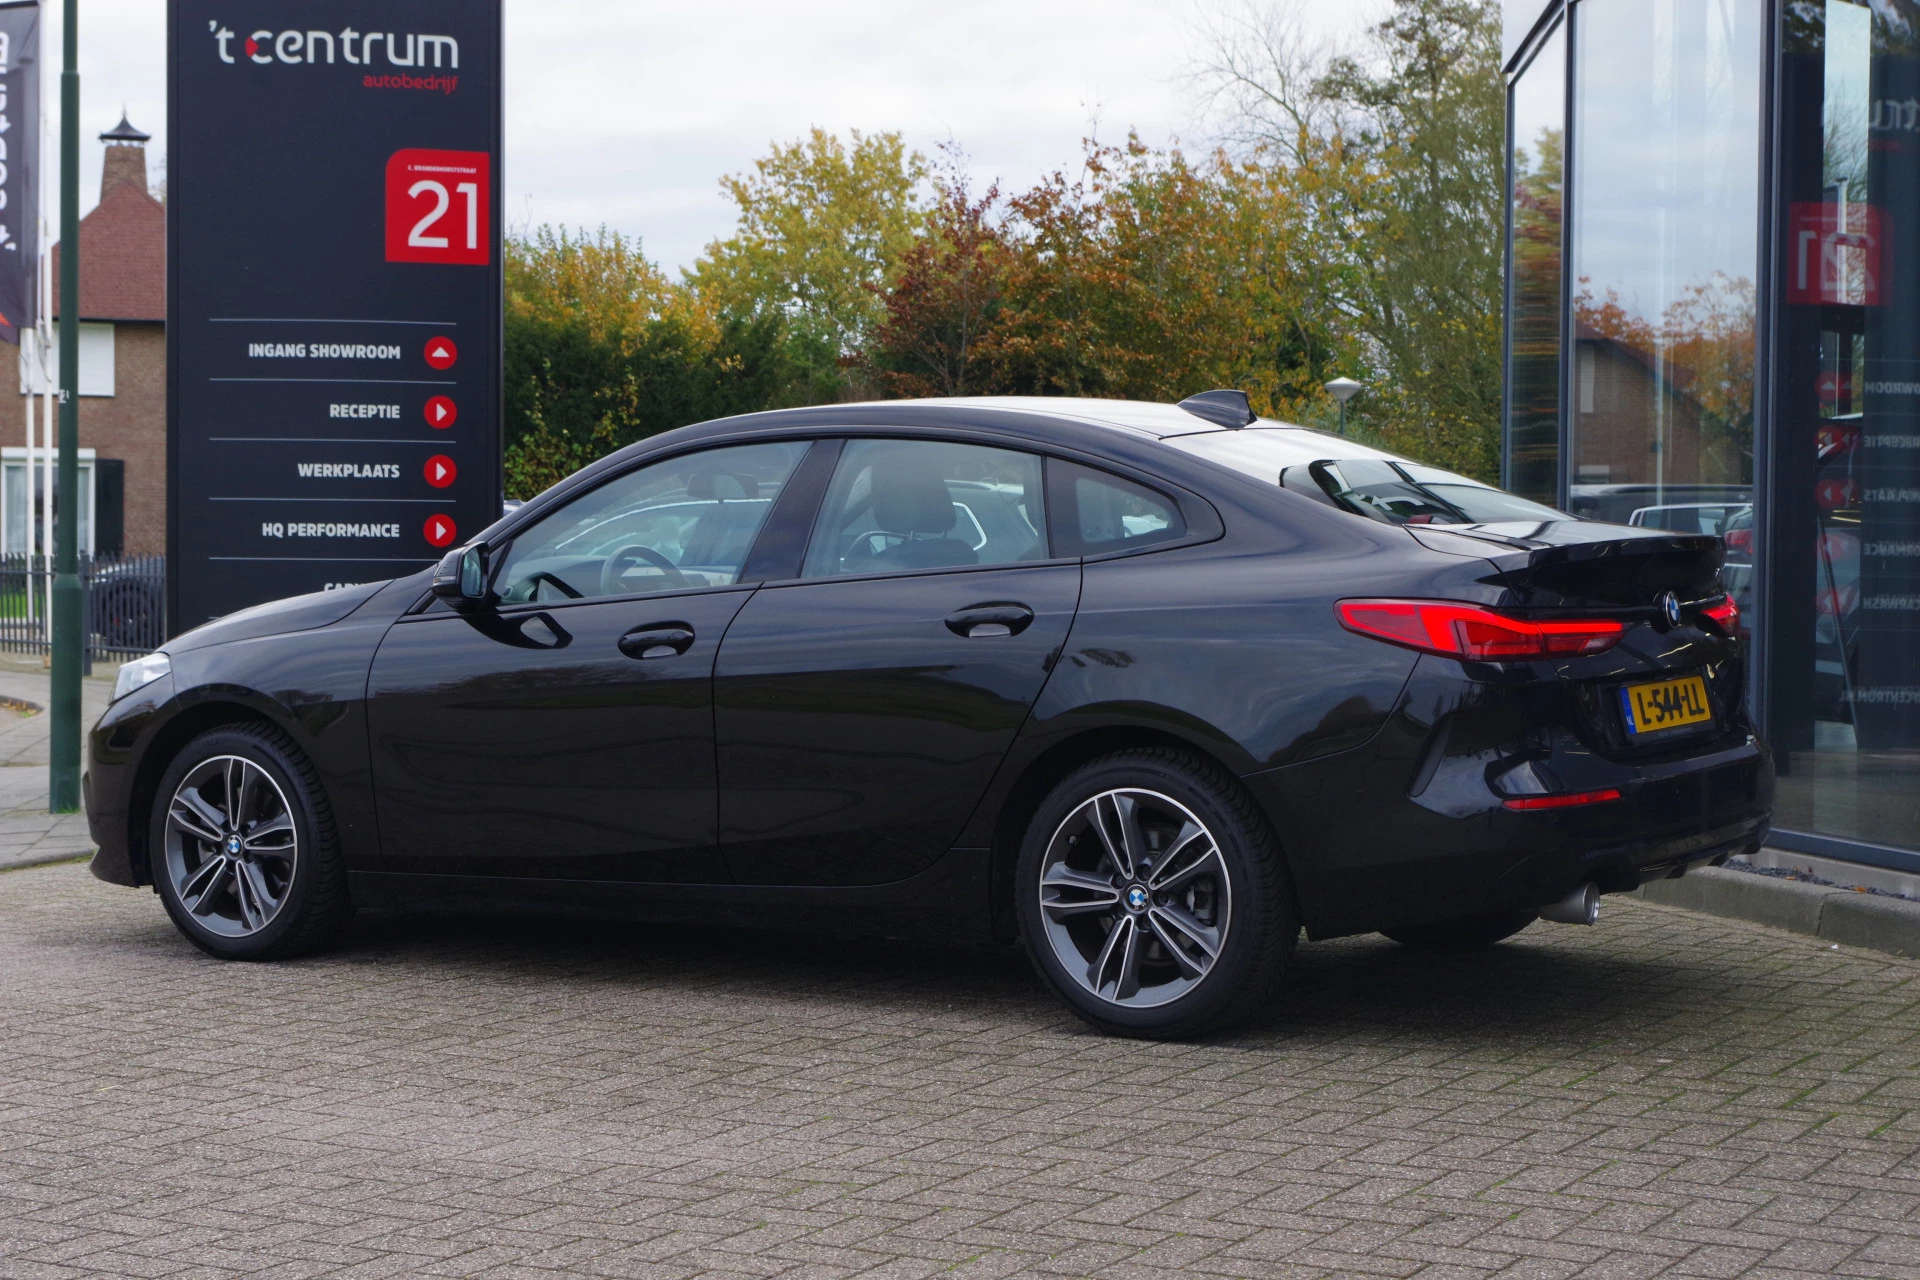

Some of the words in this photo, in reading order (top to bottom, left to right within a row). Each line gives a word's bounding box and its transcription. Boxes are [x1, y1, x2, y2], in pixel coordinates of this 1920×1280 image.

[245, 28, 459, 69] centrum
[363, 73, 459, 95] autobedrijf
[407, 179, 478, 250] 21
[248, 343, 307, 358] INGANG
[309, 344, 401, 359] SHOWROOM
[329, 404, 401, 419] RECEPTIE
[297, 463, 401, 479] WERKPLAATS
[262, 523, 284, 538] HQ
[287, 523, 400, 538] PERFORMANCE
[1636, 683, 1706, 725] L-544-LL
